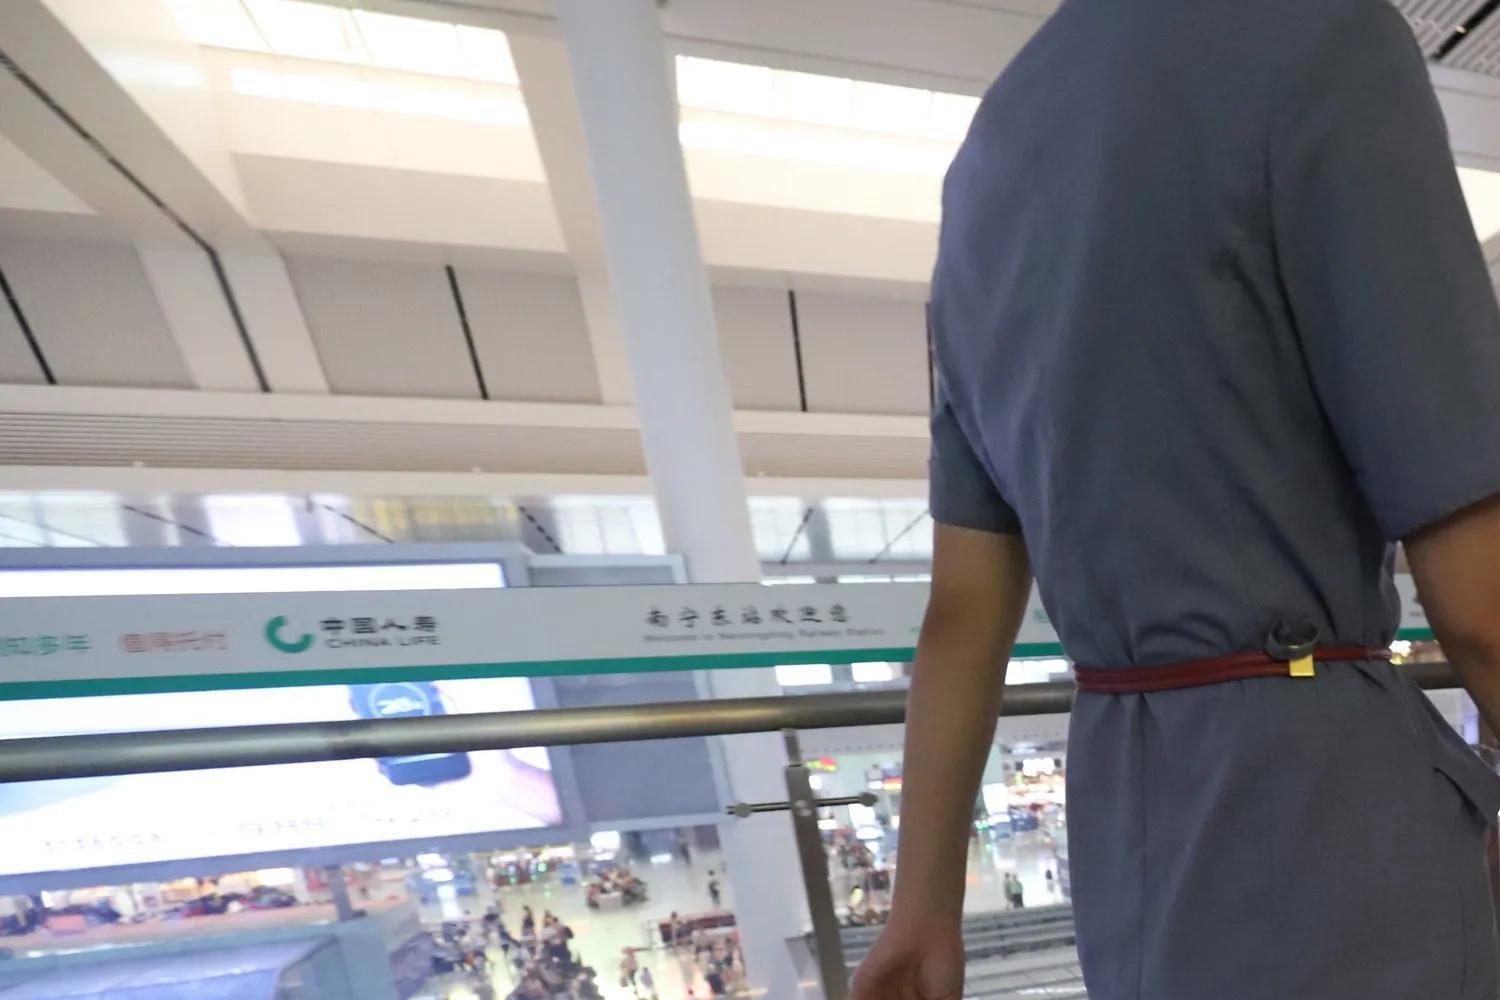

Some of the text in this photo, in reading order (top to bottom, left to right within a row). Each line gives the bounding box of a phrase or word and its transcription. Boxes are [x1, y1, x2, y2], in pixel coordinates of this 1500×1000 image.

[320, 616, 437, 634] 中国人寿
[645, 603, 850, 629] 南宁东站欢迎您
[327, 635, 440, 649] CHINA LIFE
